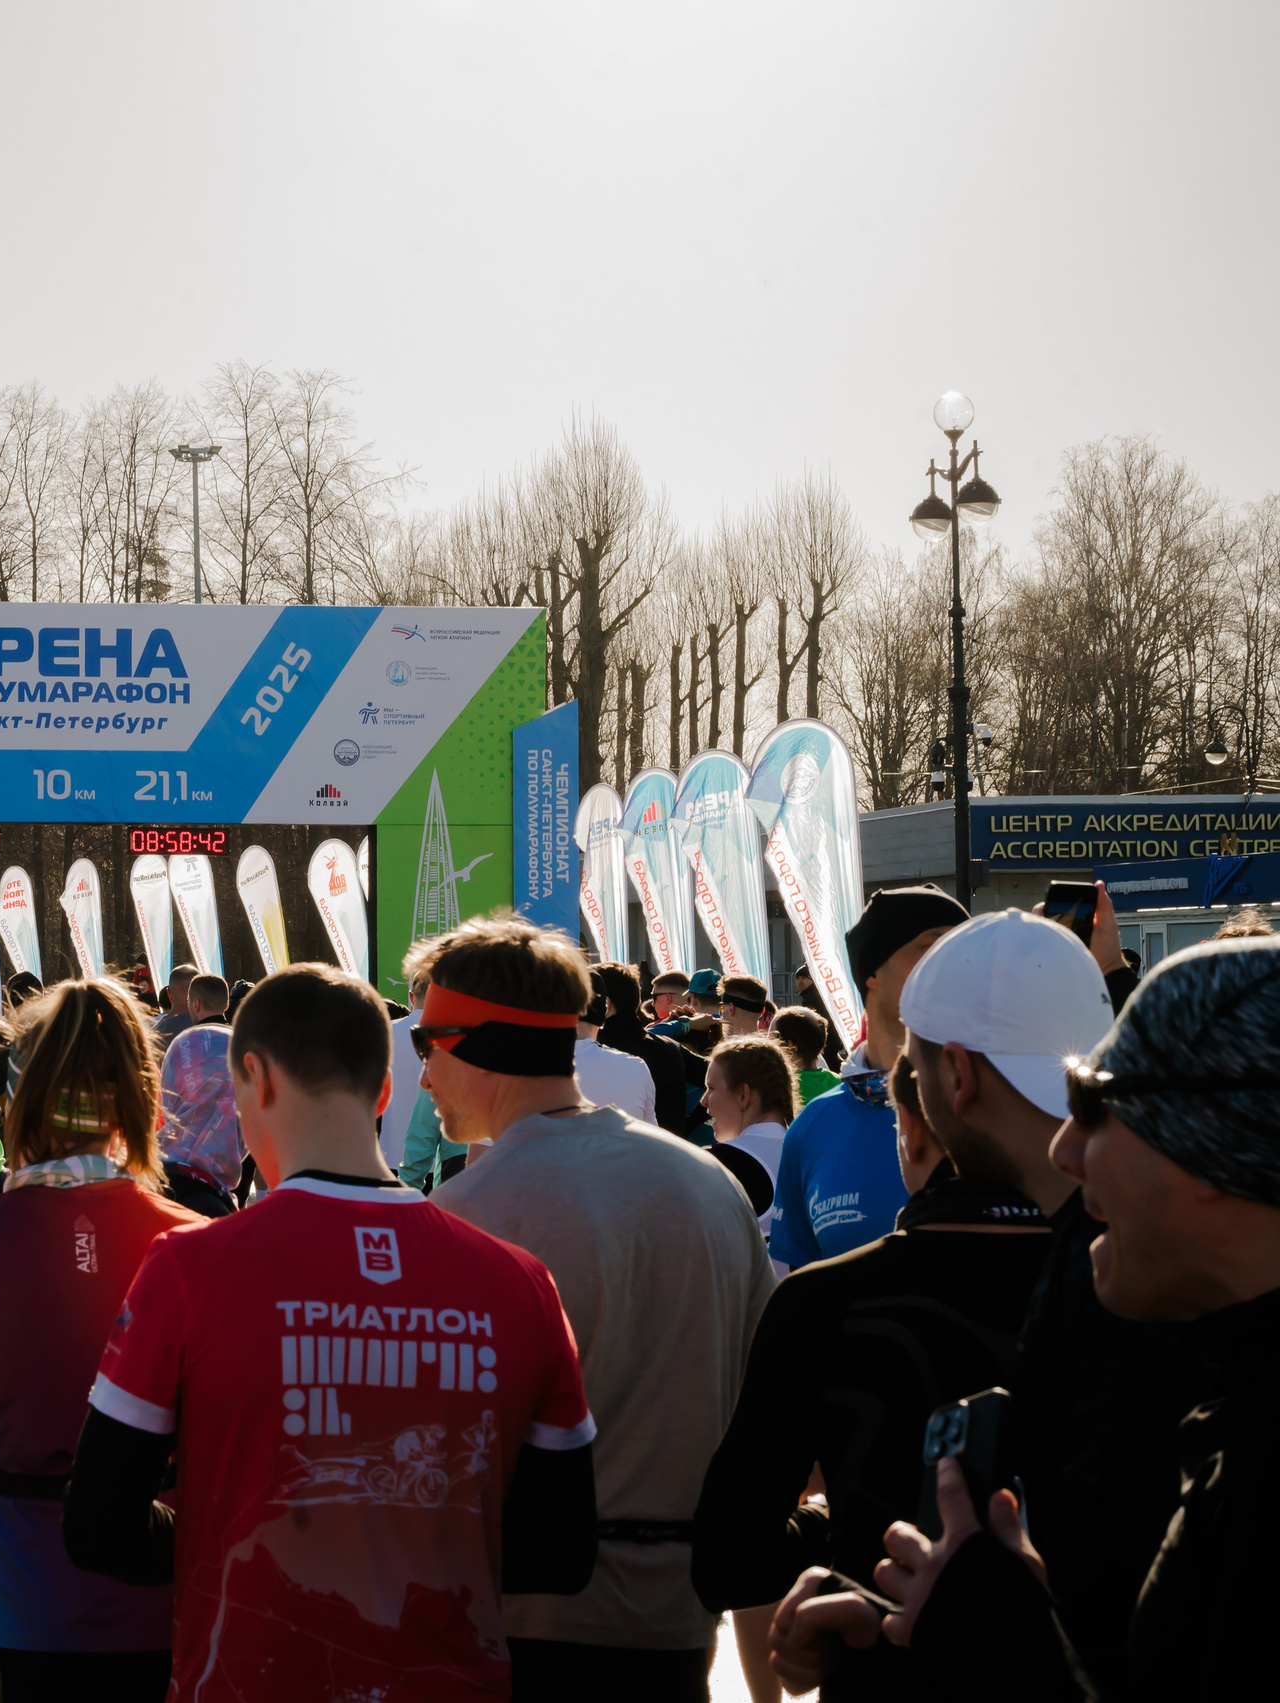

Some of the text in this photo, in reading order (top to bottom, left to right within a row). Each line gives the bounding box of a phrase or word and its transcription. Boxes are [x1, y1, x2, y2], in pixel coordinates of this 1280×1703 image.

[240, 641, 311, 737] 2025
[32, 769, 96, 801] 10 КМ
[134, 770, 213, 806] 21,1 КМ
[131, 830, 226, 853] 08:58:42
[527, 749, 540, 901] ПО ПОЛУМАРАФОНУ
[541, 748, 555, 899] САНКТ-ПЕТЕРБУРГА
[556, 763, 570, 884] ЧЕМПИОНАТ
[989, 813, 1280, 834] ЦЕНТР АККРЕДИТАЦИИ
[989, 840, 1178, 859] ACCREDITATION
[77, 1232, 90, 1273] ALTAI
[276, 1300, 493, 1338] ТРИАТЛОН
